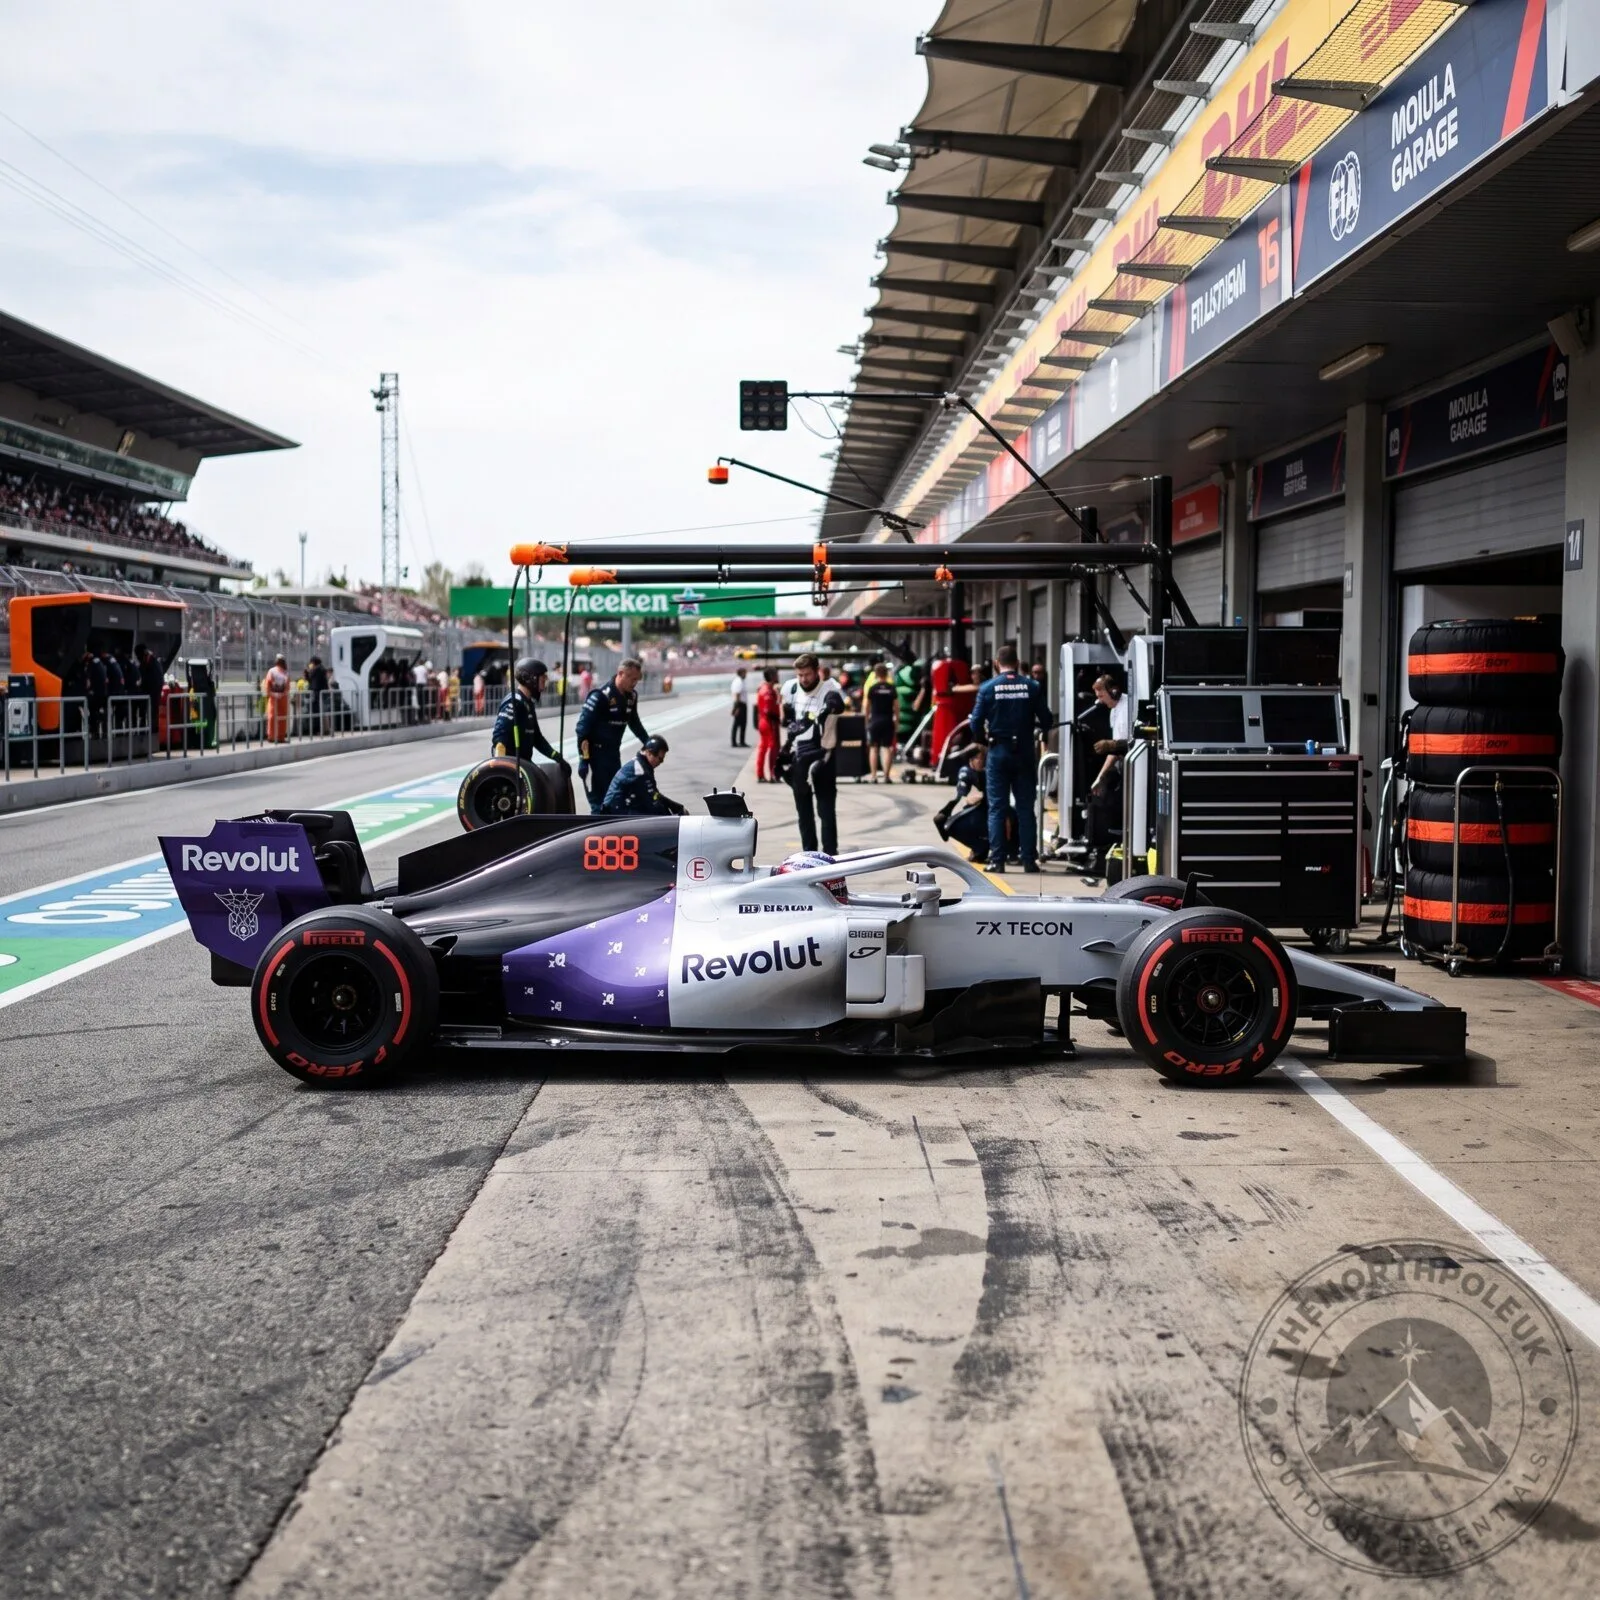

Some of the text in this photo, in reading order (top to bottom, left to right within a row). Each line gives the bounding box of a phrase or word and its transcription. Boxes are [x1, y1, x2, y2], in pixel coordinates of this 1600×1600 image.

[1392, 62, 1456, 150] MOIULA
[1392, 106, 1458, 192] GARAGE
[1258, 217, 1279, 288] 16
[1450, 412, 1487, 443] GARAGE
[182, 845, 300, 873] Revolut
[584, 835, 639, 870] 888
[693, 861, 705, 879] E
[303, 930, 366, 946] PIRELLI
[976, 922, 1073, 936] 7X TECON
[1181, 927, 1244, 943] PIRELLI
[681, 936, 823, 984] Revolut
[286, 1051, 364, 1077] ZERO
[1163, 1042, 1265, 1076] P ZERO
